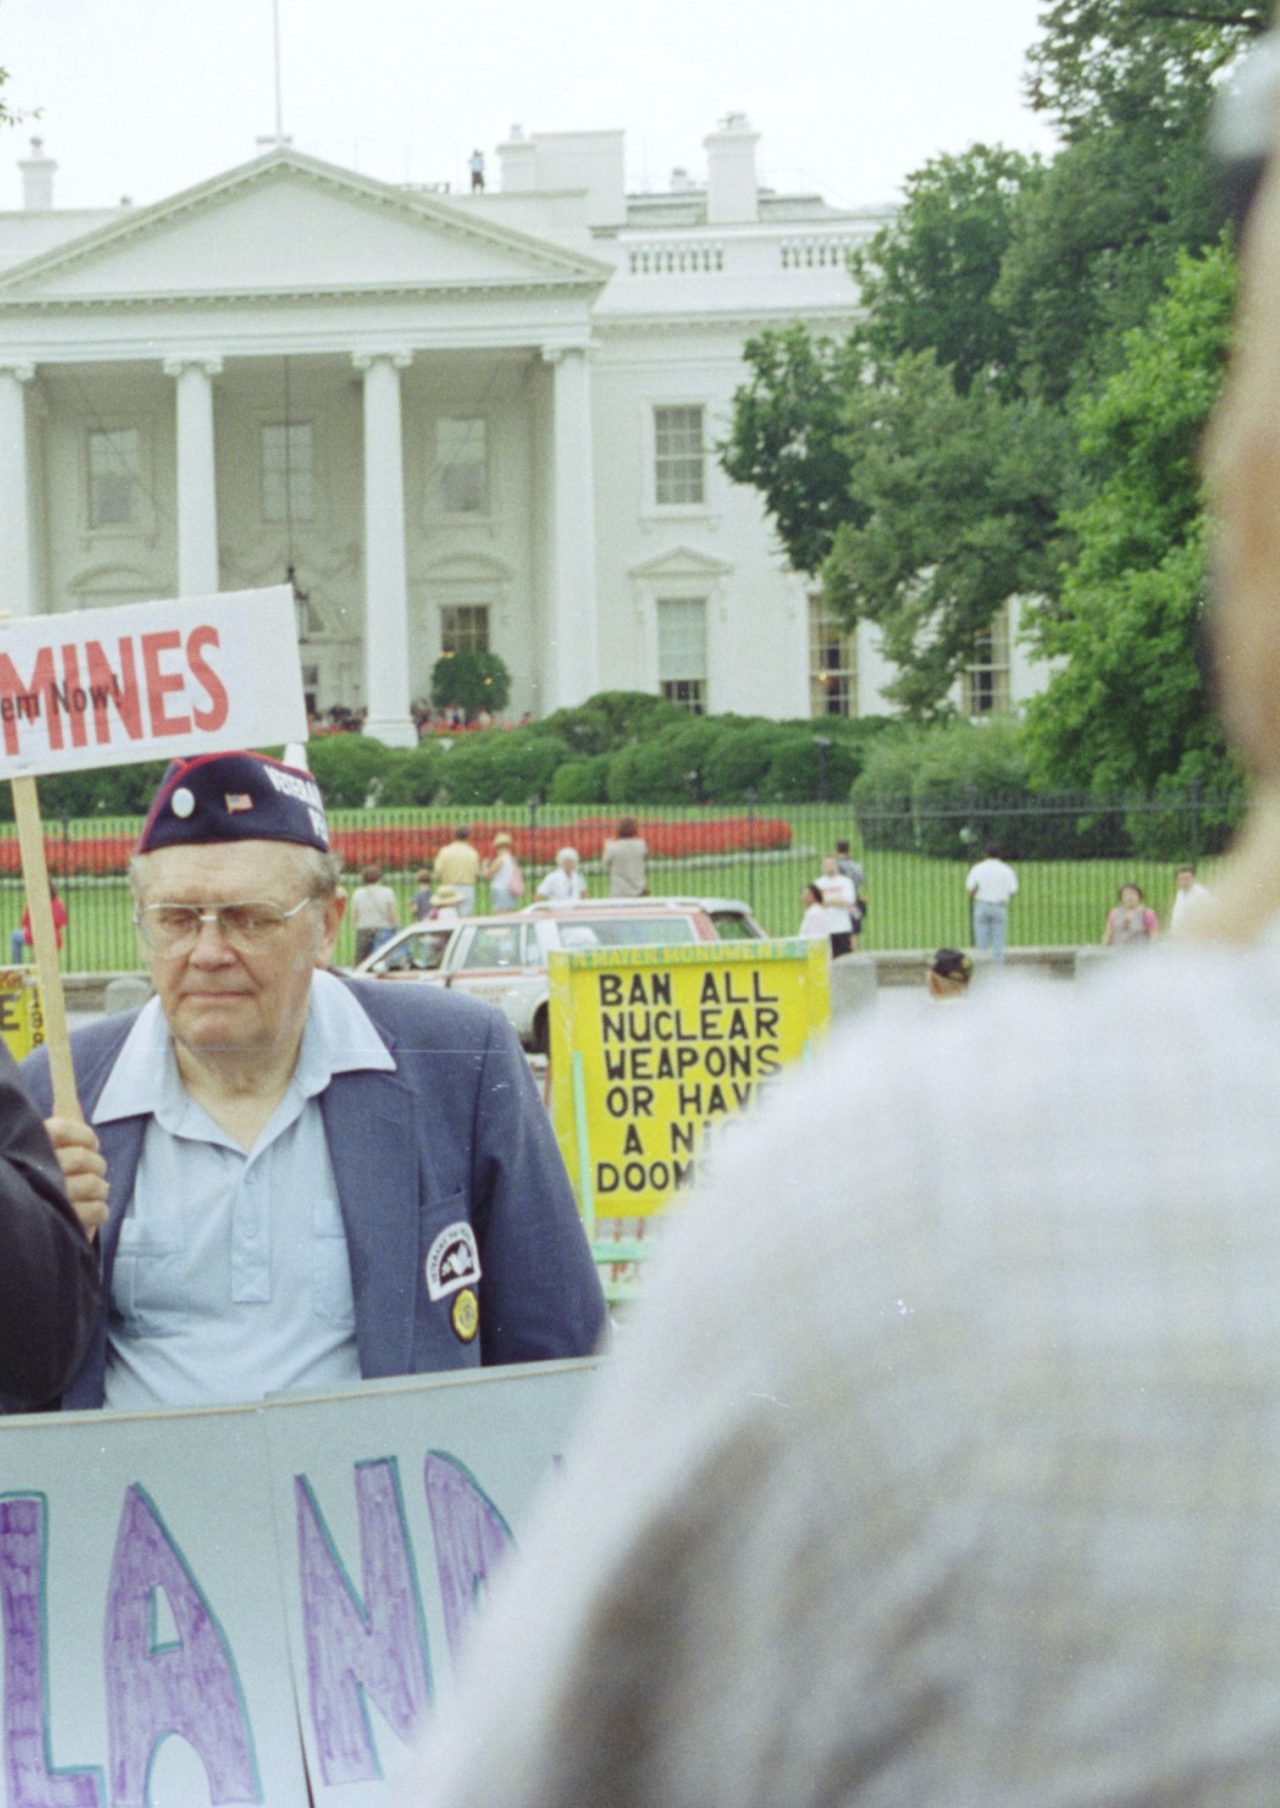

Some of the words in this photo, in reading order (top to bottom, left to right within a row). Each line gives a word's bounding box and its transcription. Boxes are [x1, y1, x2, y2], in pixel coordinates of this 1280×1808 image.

[49, 673, 122, 717] Now!
[598, 972, 673, 1007] BAN
[699, 970, 779, 1005] ALL
[601, 1007, 780, 1043] NUCLEAR
[604, 1044, 784, 1081] WEAPONS
[606, 1085, 655, 1117] OR
[623, 1122, 645, 1156] A
[597, 1160, 706, 1194] DOOM
